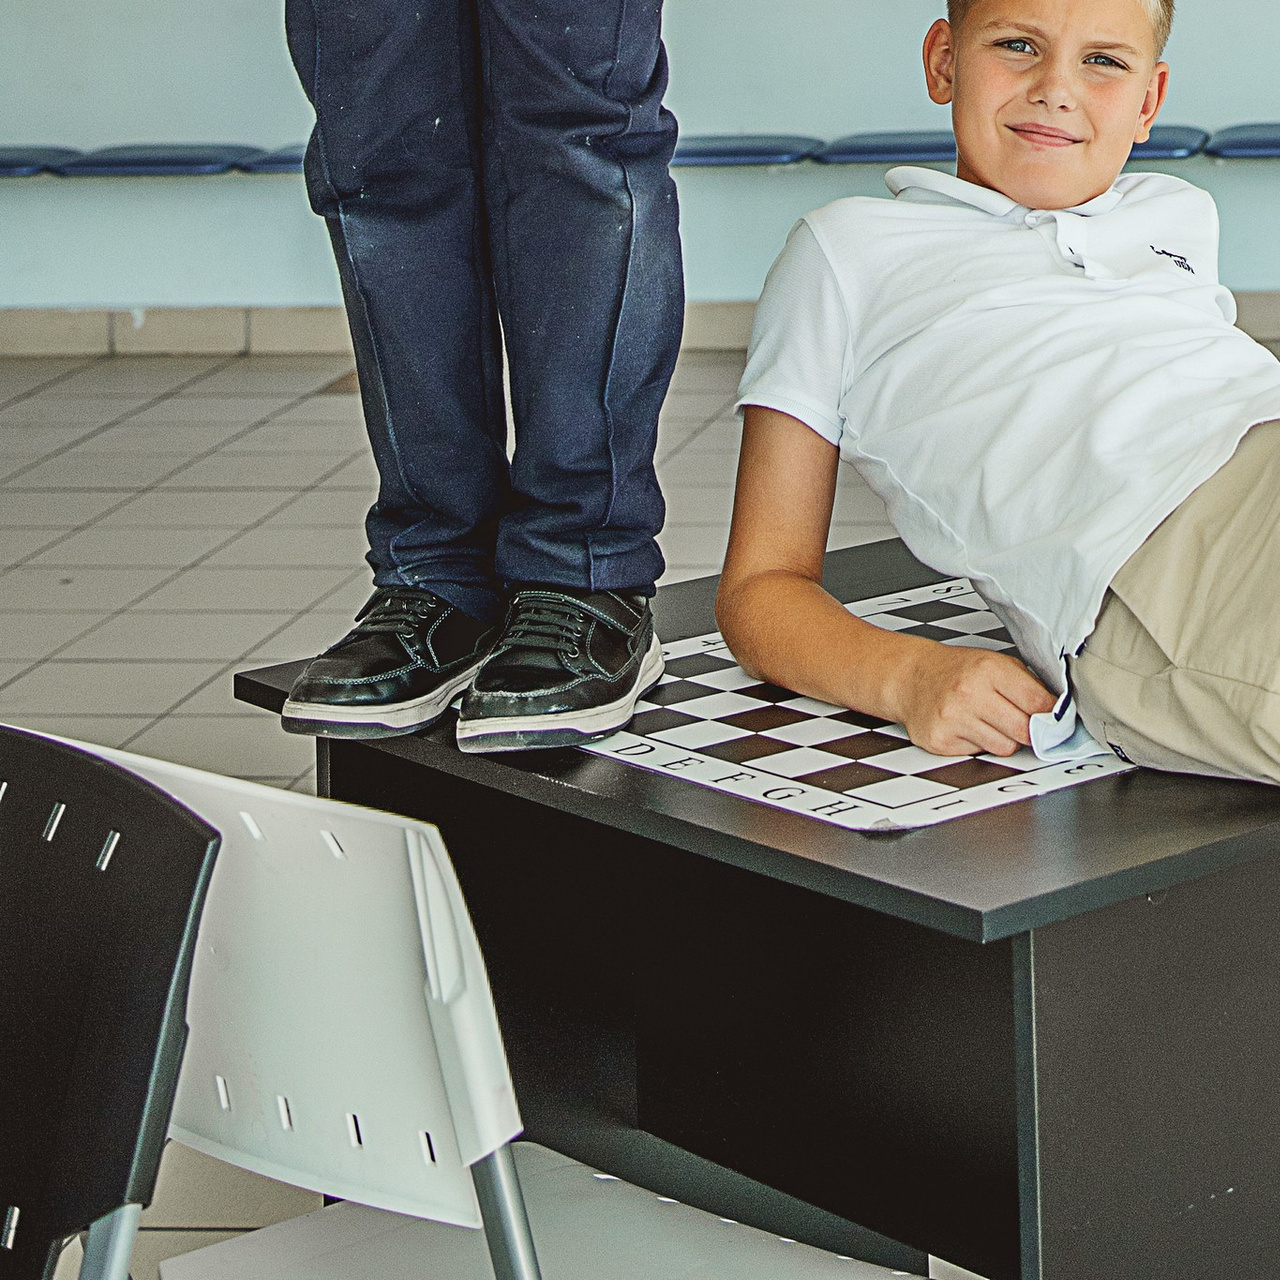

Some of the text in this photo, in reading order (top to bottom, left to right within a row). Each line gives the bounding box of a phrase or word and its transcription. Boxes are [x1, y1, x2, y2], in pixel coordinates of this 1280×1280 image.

[932, 585, 965, 595] 8
[610, 742, 863, 817] D E F G H
[931, 763, 1104, 811] 1 2 3
